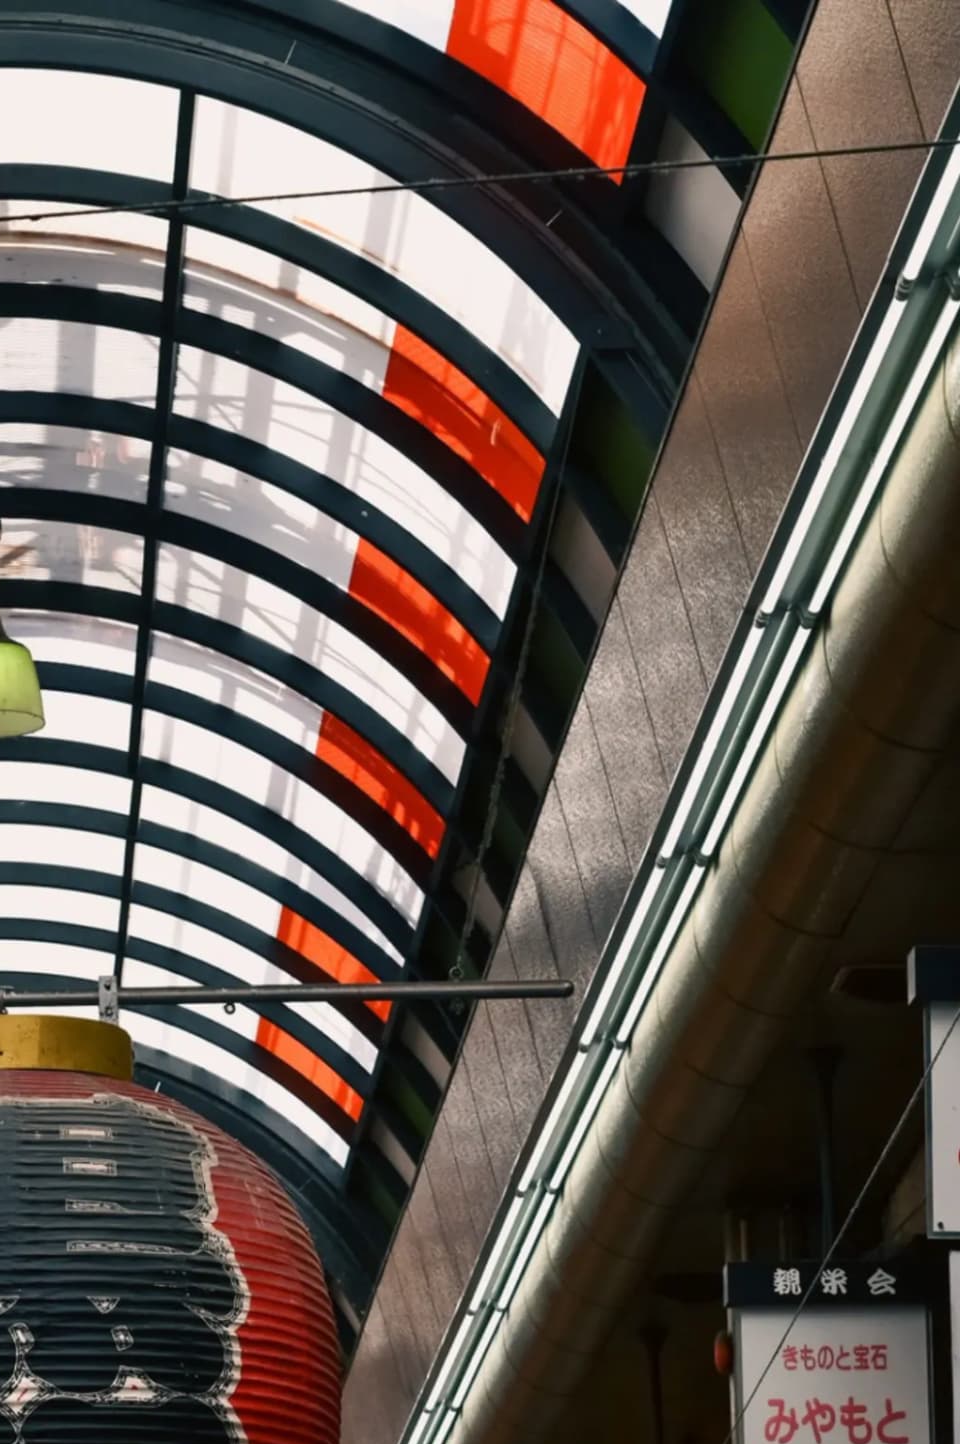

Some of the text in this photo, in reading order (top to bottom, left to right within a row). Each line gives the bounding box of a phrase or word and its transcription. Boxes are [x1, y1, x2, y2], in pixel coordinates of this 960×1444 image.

[782, 1344, 888, 1371] きものと宝石
